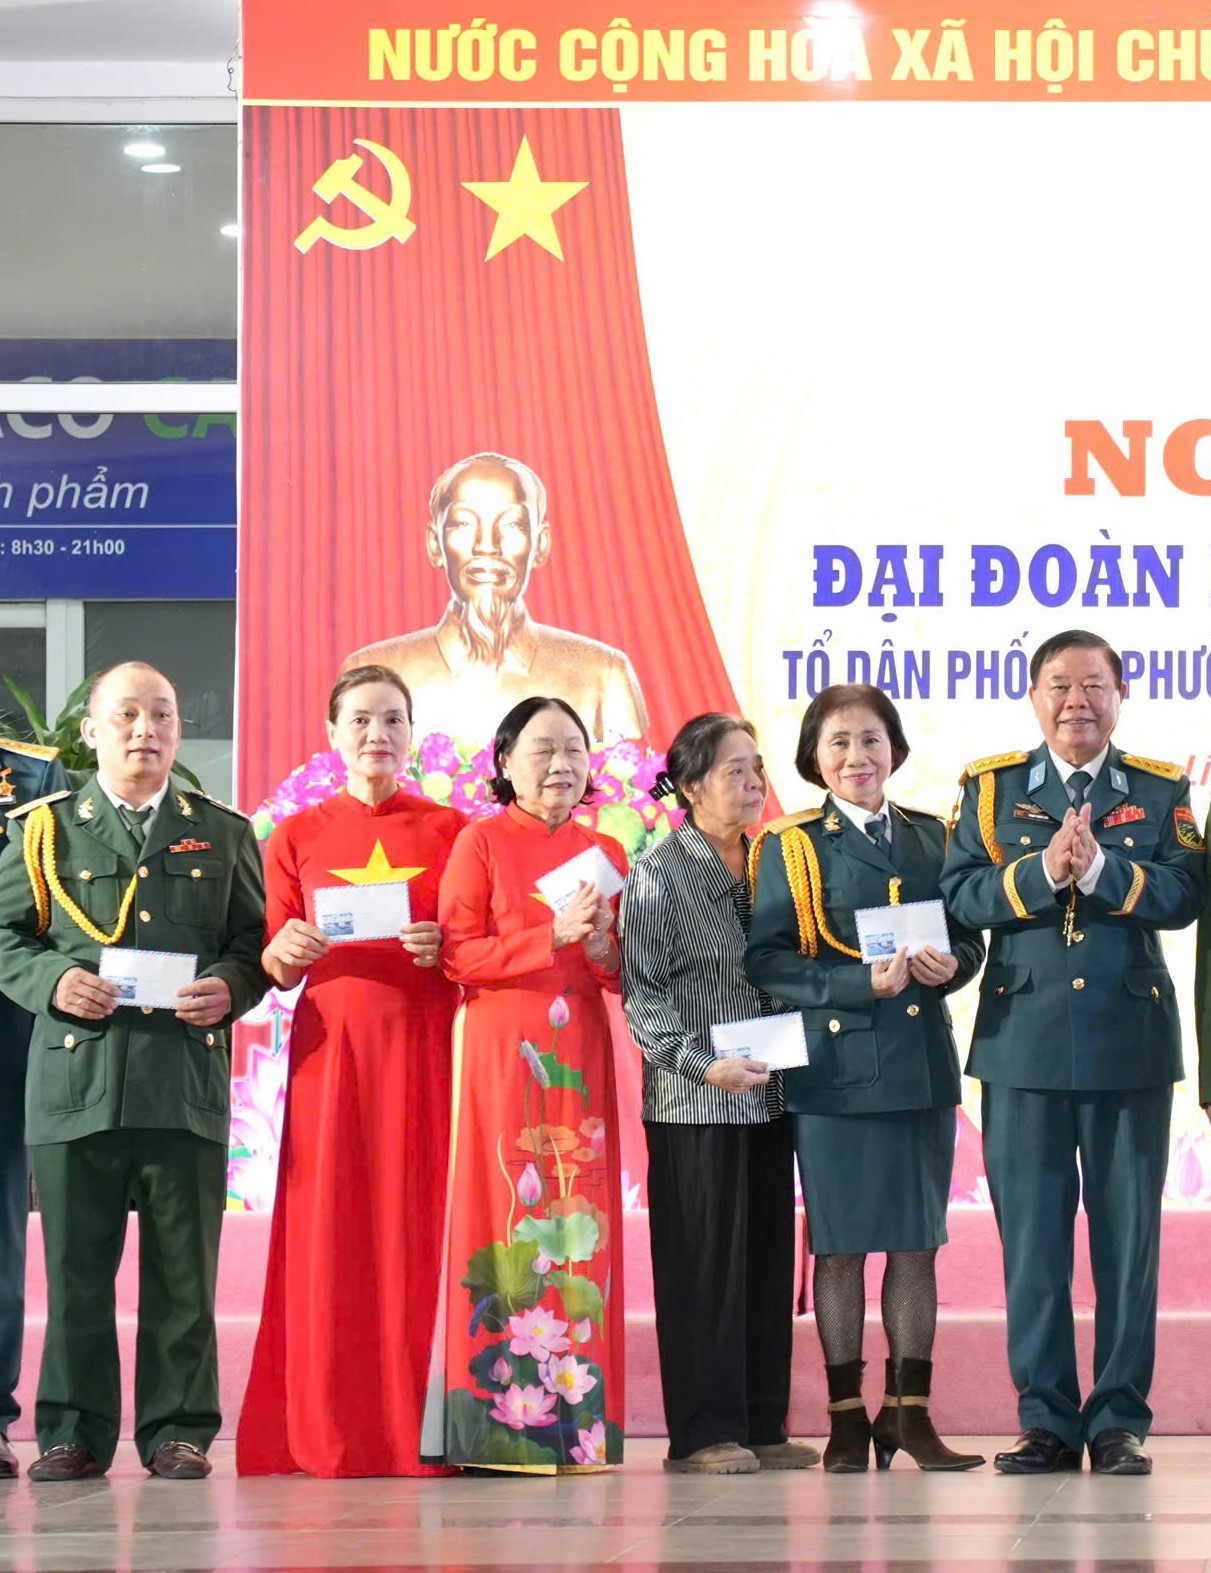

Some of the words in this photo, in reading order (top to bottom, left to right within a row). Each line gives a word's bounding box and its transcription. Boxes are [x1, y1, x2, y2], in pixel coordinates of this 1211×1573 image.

[368, 18, 537, 81] NƯỚC
[559, 18, 727, 93] CỘNG
[748, 16, 872, 82] HÒA
[890, 18, 974, 81] XÃ
[994, 18, 1094, 93] HỘI
[27, 466, 149, 517] phẩm
[11, 540, 55, 556] 8h30
[71, 540, 125, 556] 21h00
[812, 544, 944, 623] ĐẠI
[970, 529, 1184, 608] ĐOÀN
[783, 629, 832, 699] TỔ
[847, 638, 931, 699] DÂN
[947, 631, 1028, 700] PHỐ
